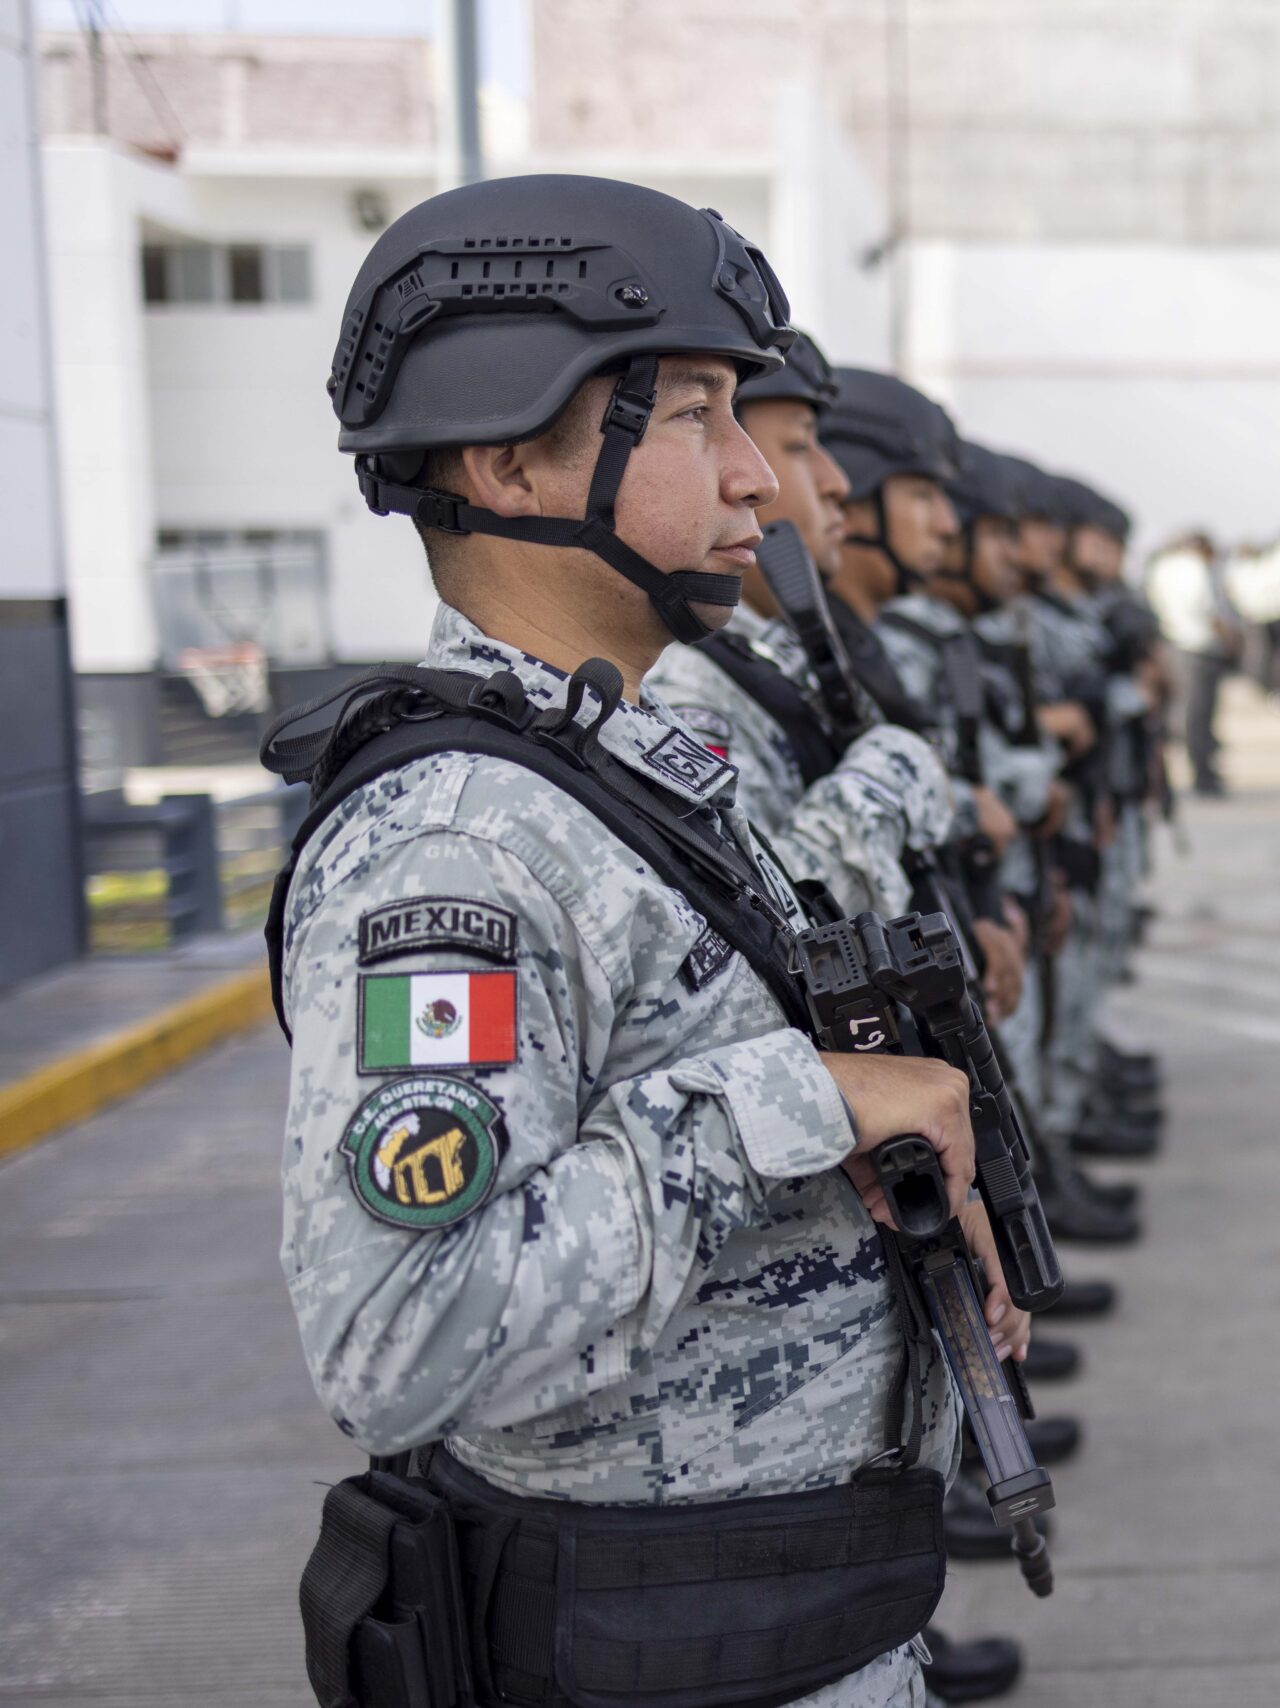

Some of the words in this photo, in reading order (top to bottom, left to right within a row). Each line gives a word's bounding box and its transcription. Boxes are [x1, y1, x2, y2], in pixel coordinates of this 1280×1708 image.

[662, 740, 714, 778] GN
[371, 906, 506, 948] MEXICO
[380, 1081, 479, 1109] QUERETARO
